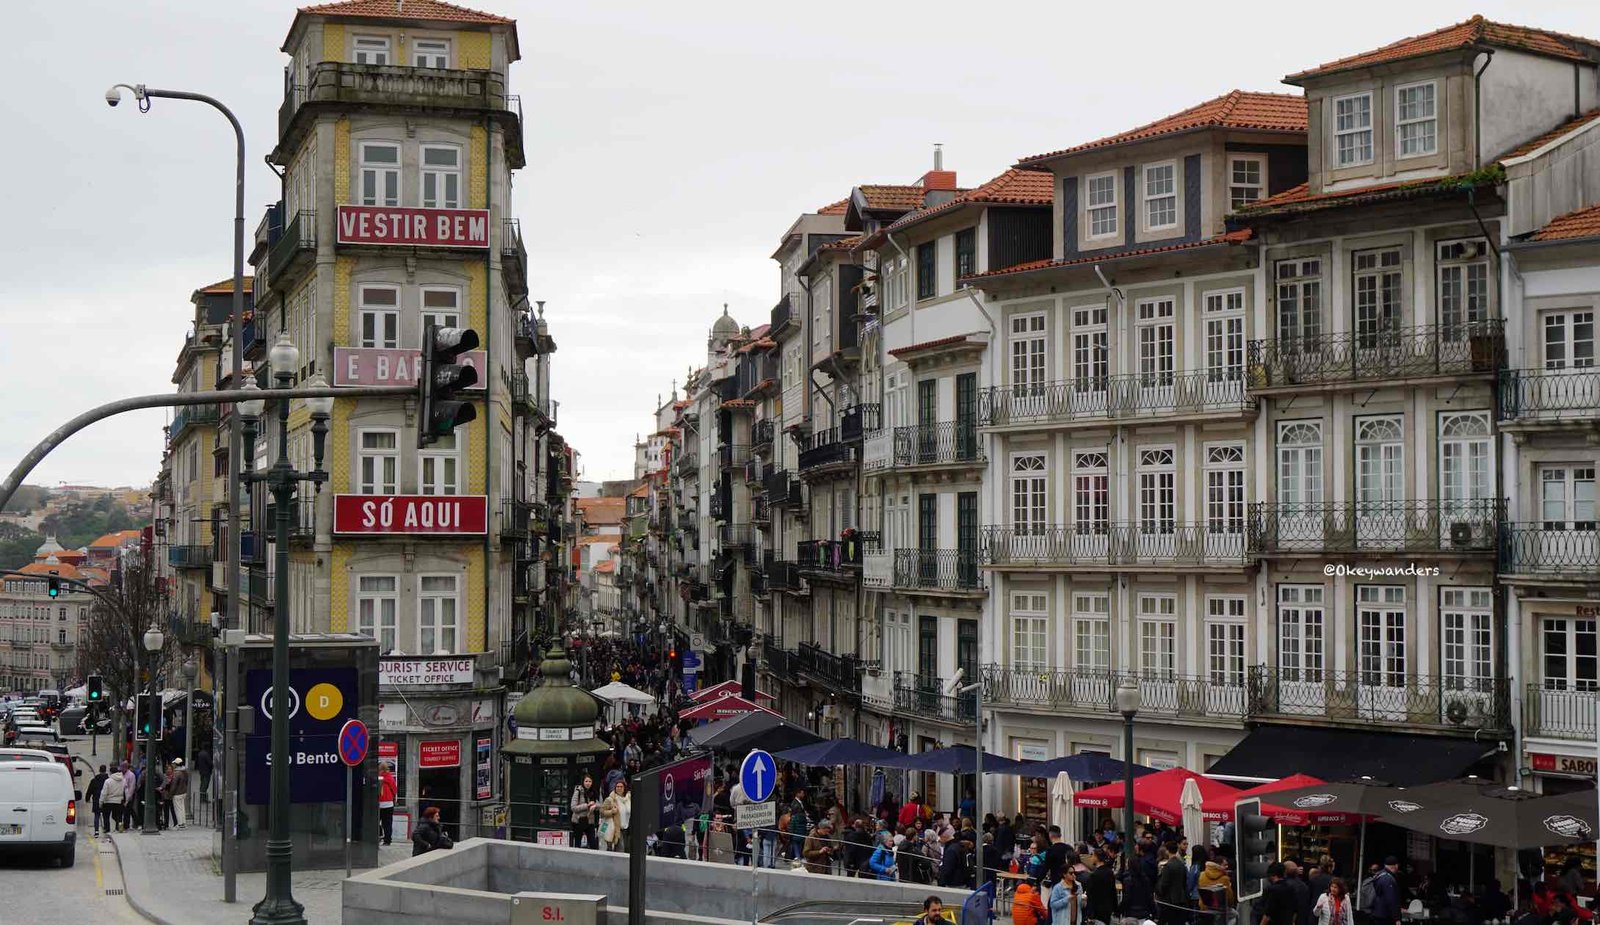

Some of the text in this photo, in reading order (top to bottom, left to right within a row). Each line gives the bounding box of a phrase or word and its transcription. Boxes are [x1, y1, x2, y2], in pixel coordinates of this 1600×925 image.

[341, 211, 485, 241] VESTIR BEM
[348, 355, 359, 380] E
[362, 497, 460, 528] SÓ AQUI
[378, 660, 470, 673] OURIST SERVICE
[388, 674, 454, 684] TICKET OFFICE
[320, 695, 329, 708] D
[296, 752, 338, 765] Bento
[542, 906, 565, 921] S.I.
